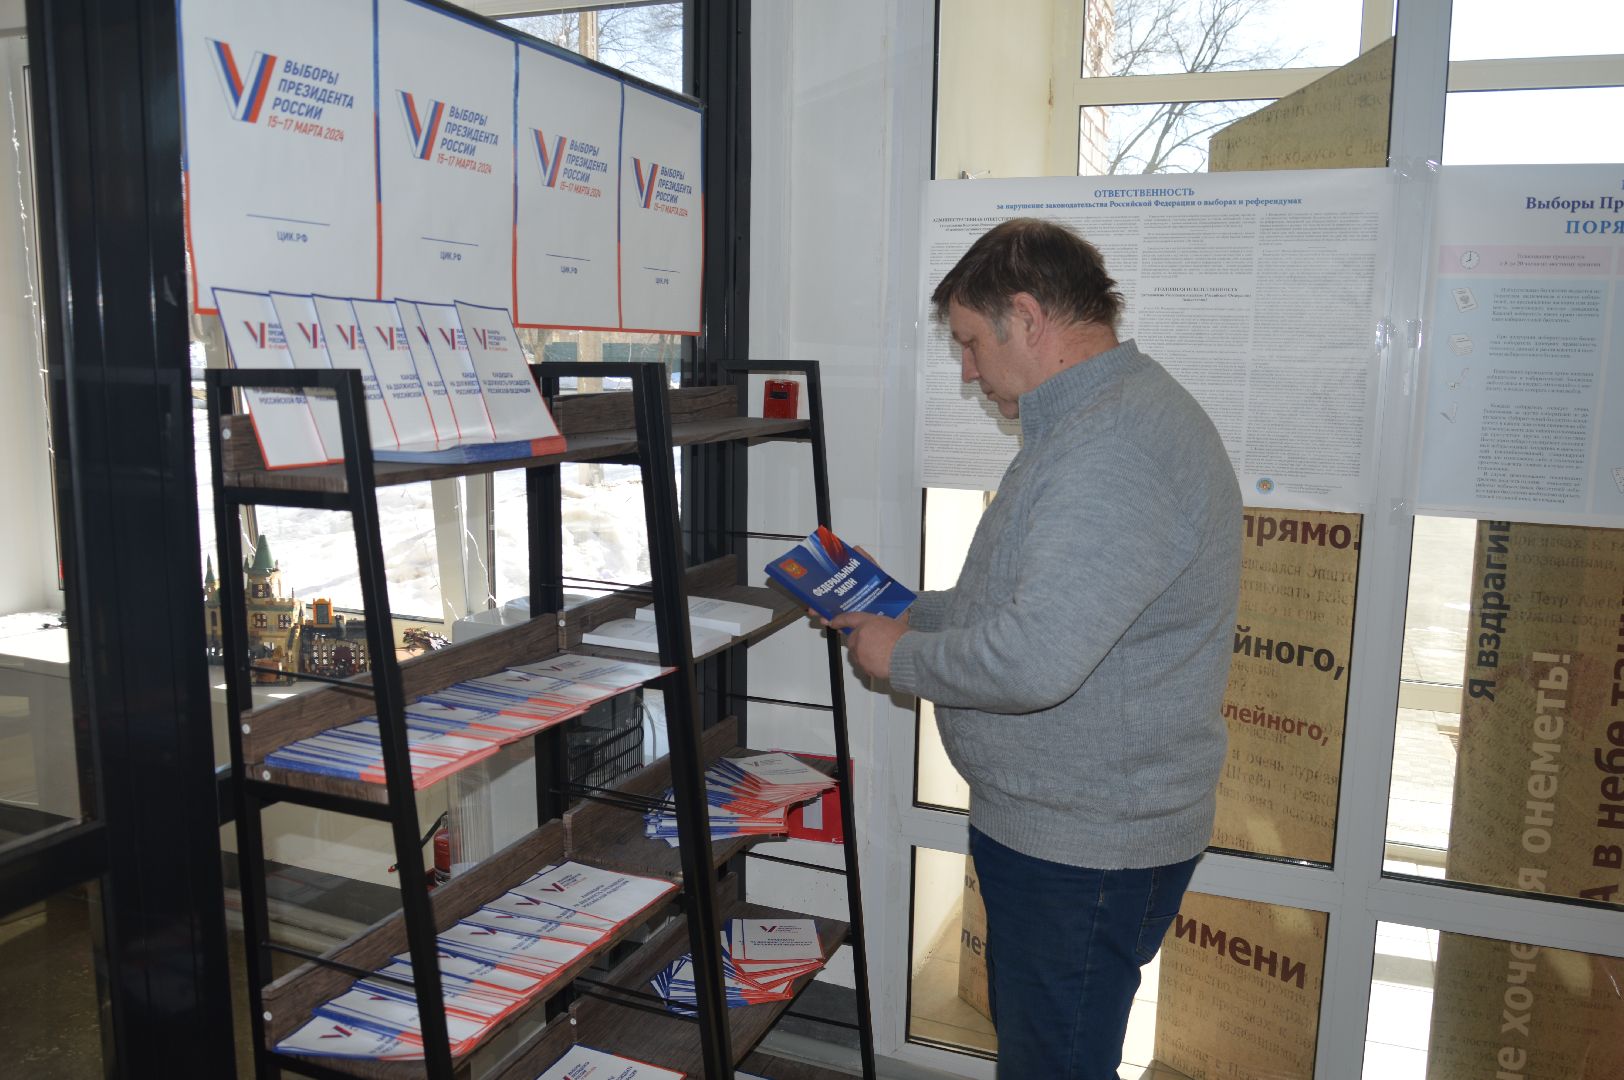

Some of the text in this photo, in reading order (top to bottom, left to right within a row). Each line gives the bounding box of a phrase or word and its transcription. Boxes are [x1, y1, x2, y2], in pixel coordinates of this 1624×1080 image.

[283, 59, 340, 86] ВЫБОРЫ
[277, 78, 355, 110] ПРЕЗИДЕНТА
[272, 97, 323, 121] РОССИИ
[449, 106, 488, 126] ВЫБОРЫ
[294, 121, 323, 138] МАРТА
[324, 128, 345, 142] 2024
[444, 122, 499, 147] ПРЕЗИДЕНТА
[440, 137, 476, 157] РОССИИ
[569, 139, 600, 156] ВЫБОРЫ
[456, 157, 478, 172] МАРТА
[478, 162, 492, 176] 2024
[566, 152, 608, 174] ПРЕЗИДЕНТА
[562, 166, 591, 184] РОССИИ
[660, 166, 685, 180] ВЫБОРЫ
[573, 182, 590, 197] МАРТА
[590, 186, 602, 199] 2024
[658, 178, 692, 196] ПРЕЗИДЕНТА
[1094, 188, 1195, 198] ОТВЕТСТВЕННОСТЬ
[655, 190, 678, 204] РОССИИ
[1045, 202, 1108, 210] законодательства
[1109, 200, 1152, 208] Российской
[1154, 200, 1196, 208] Федерации
[1204, 199, 1237, 207] выборах
[1245, 198, 1302, 206] референдумах
[1526, 196, 1624, 213] Выборы Пр
[1565, 220, 1624, 234] ПОРЯ
[276, 230, 309, 244] ЦИК.РФ
[440, 250, 462, 262] ЦИК.РФ
[812, 557, 861, 597] ФЕДЕРАЛЬНЫЙ
[834, 577, 858, 597] ЗАКОН
[1220, 703, 1328, 746] лейного,
[1521, 651, 1571, 854] онеметь!
[1174, 914, 1306, 989] имени
